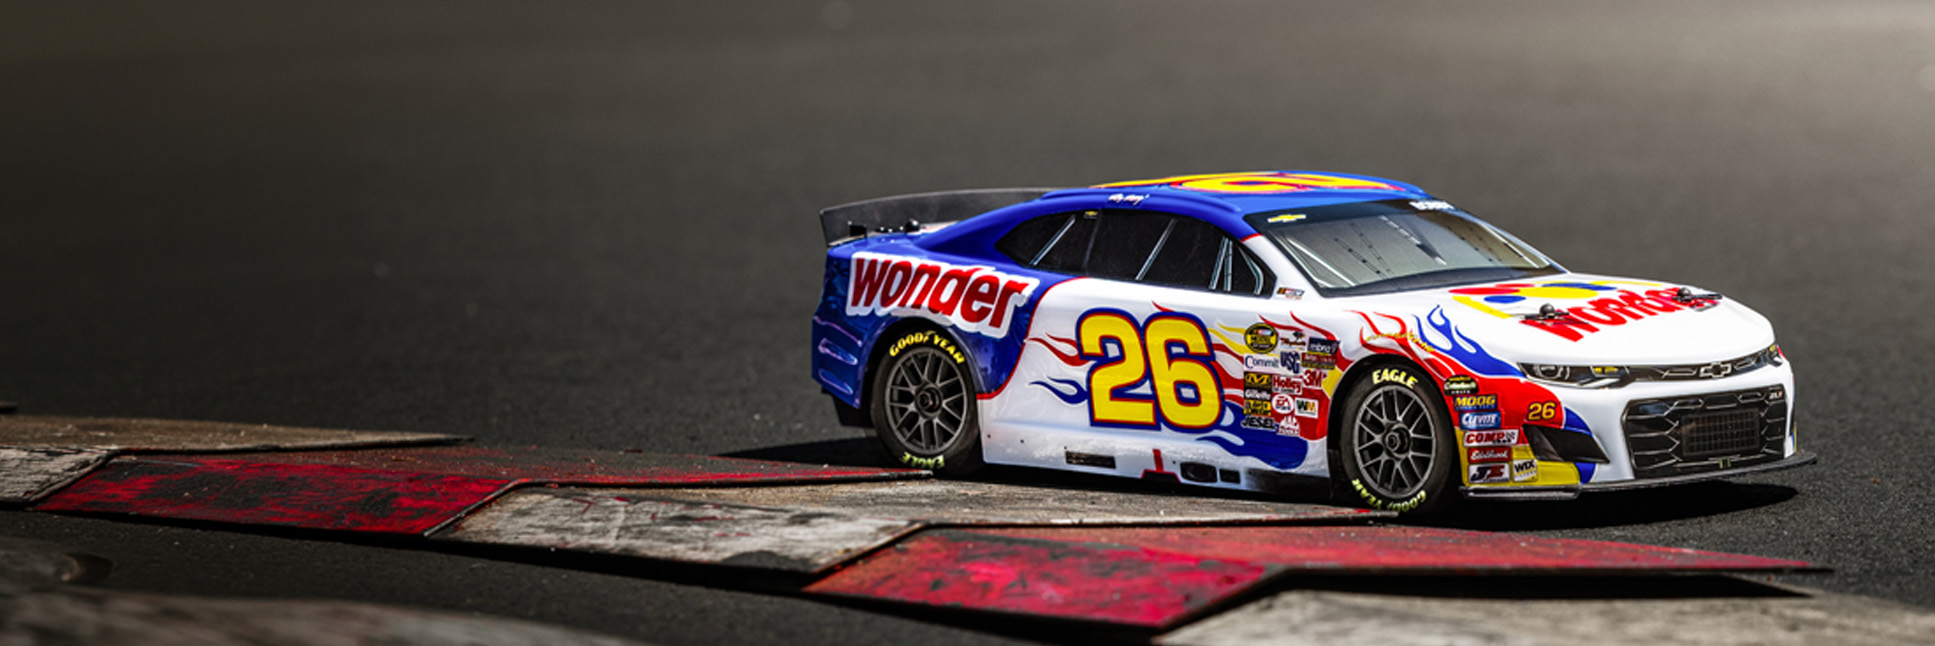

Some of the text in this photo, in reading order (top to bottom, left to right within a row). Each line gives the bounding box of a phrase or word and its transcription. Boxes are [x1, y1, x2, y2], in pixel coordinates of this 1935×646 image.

[850, 257, 1030, 328] wonder
[1079, 310, 1225, 431] 26
[1372, 368, 1418, 389] EAGLE
[1455, 395, 1496, 407] MOOG
[1528, 401, 1557, 421] 26
[1466, 431, 1506, 444] COMP
